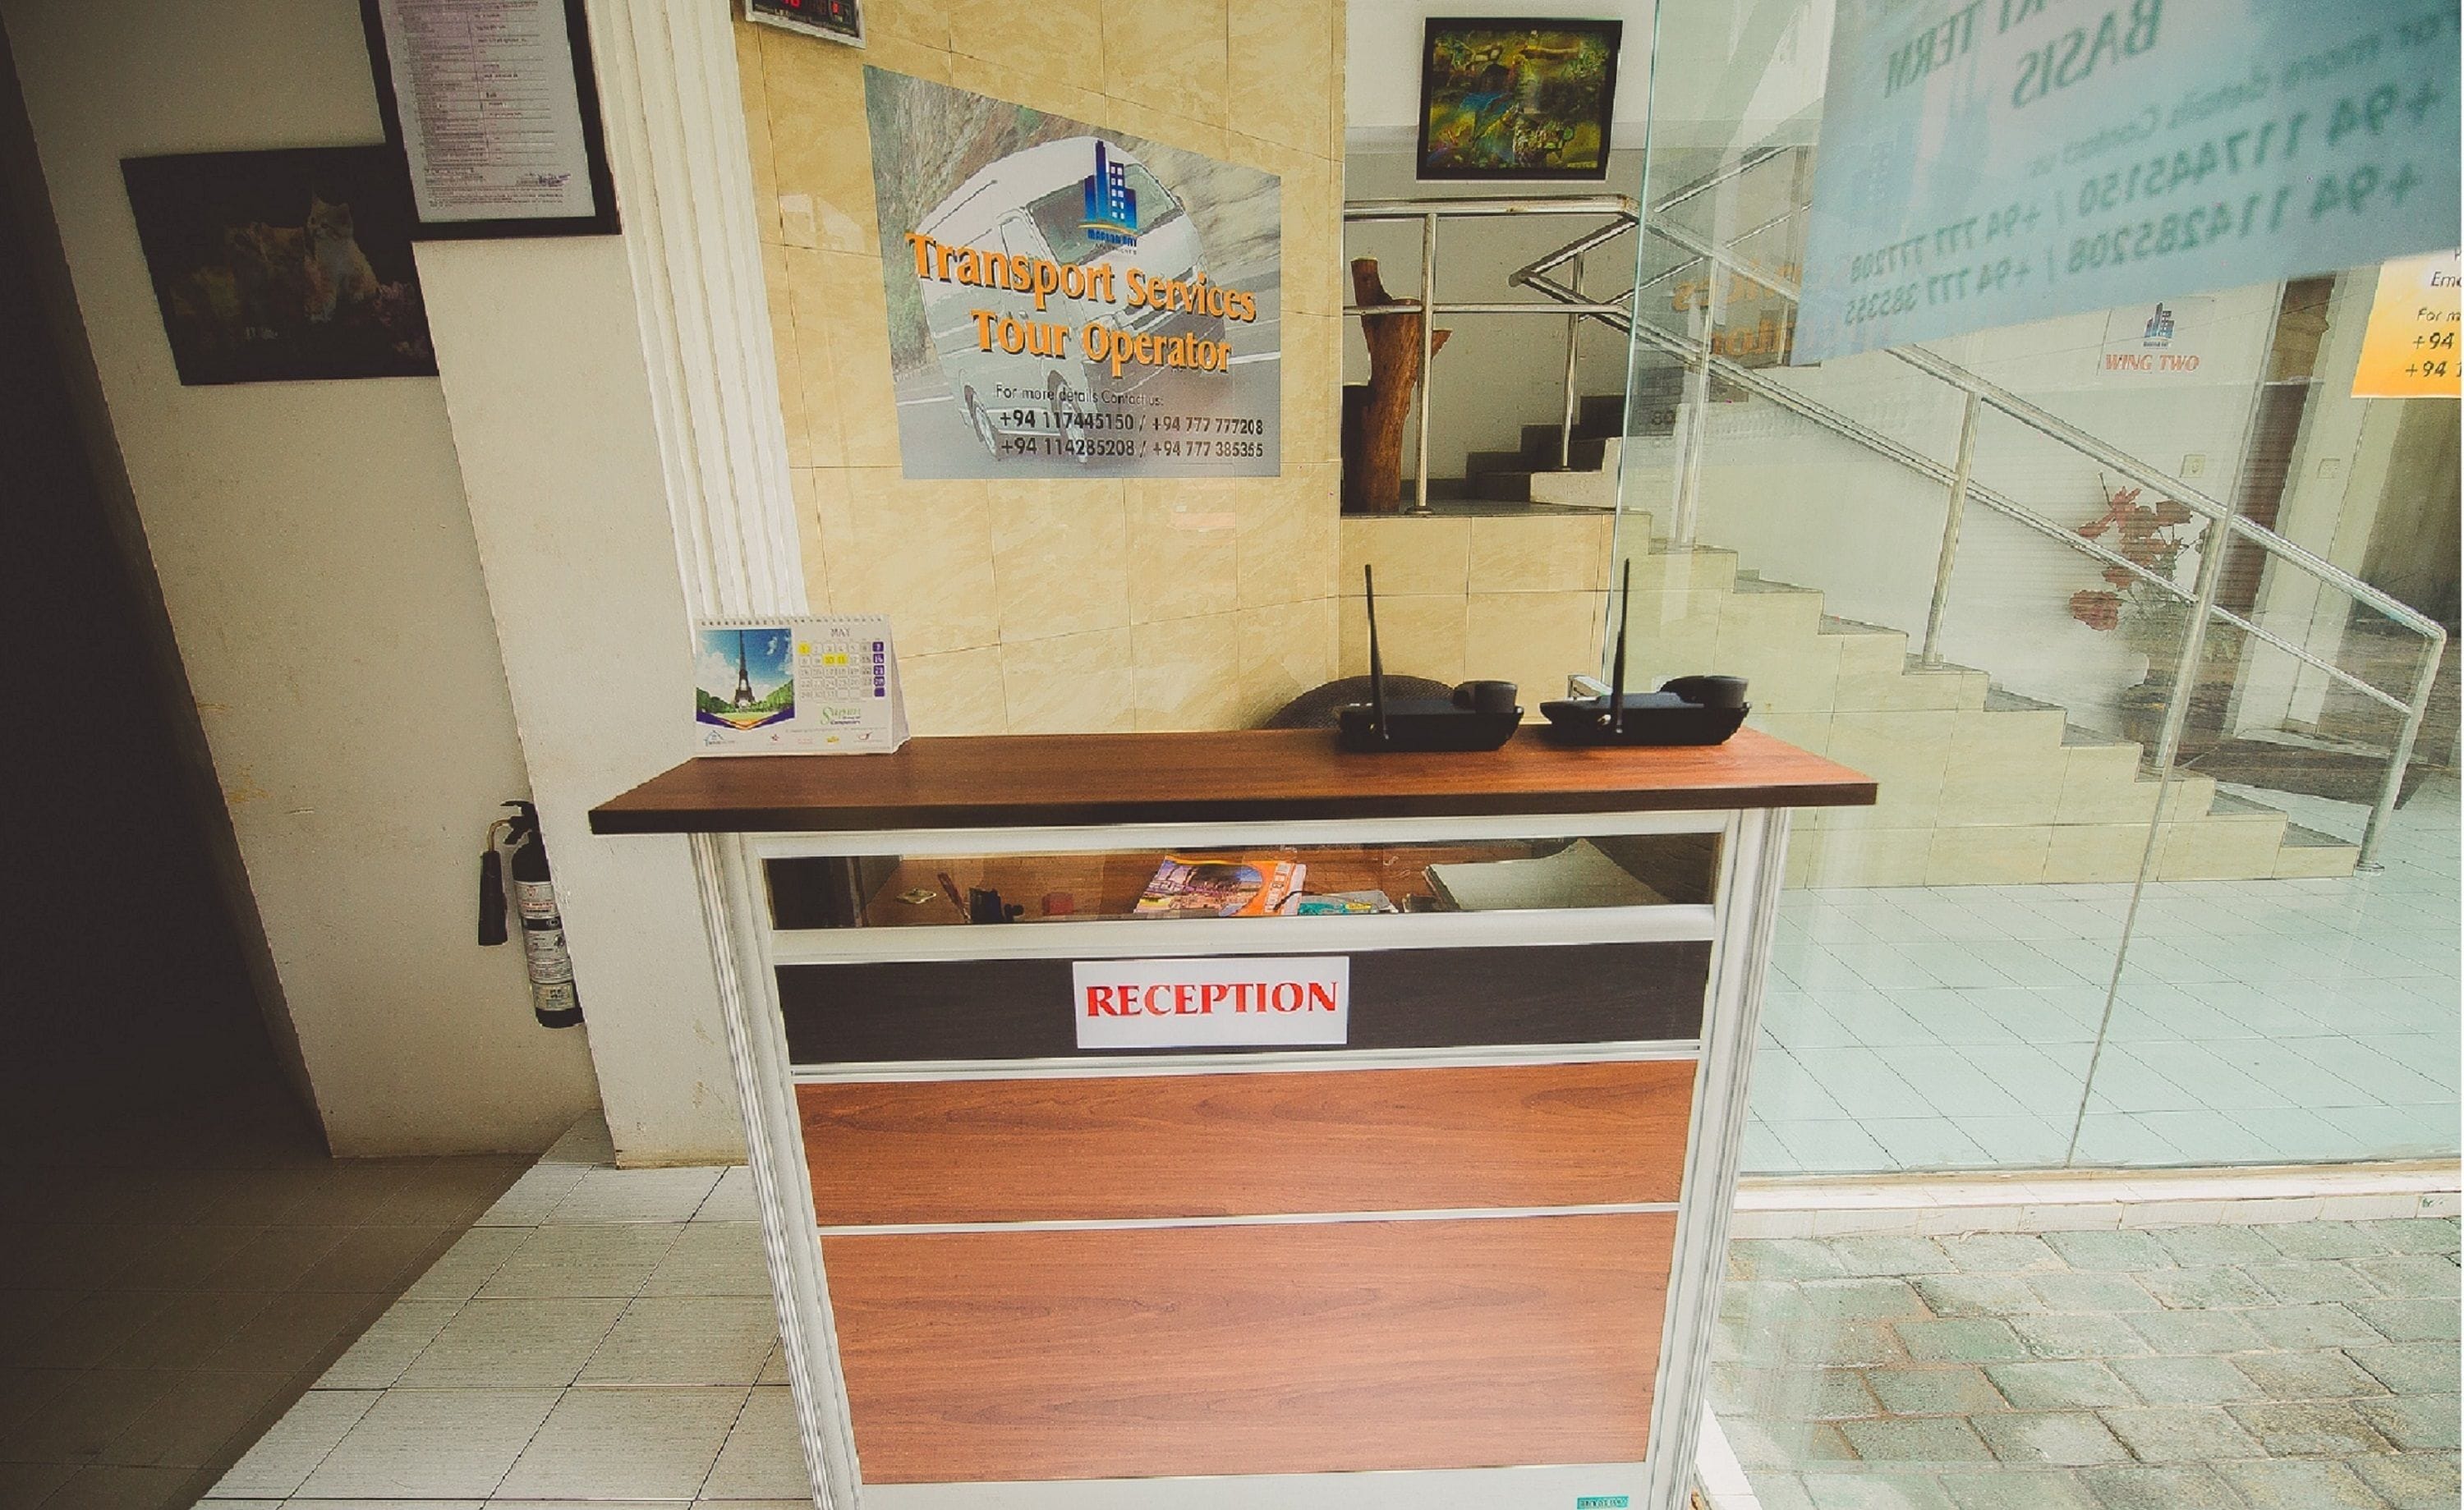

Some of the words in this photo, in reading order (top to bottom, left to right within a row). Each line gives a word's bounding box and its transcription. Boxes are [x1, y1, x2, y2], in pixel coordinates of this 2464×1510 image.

[904, 232, 1115, 312] Transport
[1126, 267, 1257, 323] Services
[2416, 308, 2443, 322] For
[970, 309, 1071, 360] Tour
[1083, 321, 1232, 379] Operator
[2412, 333, 2454, 350] +94
[2106, 354, 2154, 371] WING
[2159, 354, 2200, 372] TWO
[2405, 360, 2448, 378] +94
[996, 384, 1017, 398] For
[1023, 389, 1055, 401] more
[1060, 387, 1098, 403] details
[1101, 389, 1145, 405] Contact
[1000, 410, 1036, 428] +94
[1043, 412, 1134, 430] 117445150
[1152, 415, 1181, 432] +94
[1186, 416, 1211, 433] 777
[1215, 418, 1264, 435] 777208
[1001, 437, 1037, 455] +94
[1044, 439, 1135, 457] 114285208
[1153, 440, 1181, 457] +94
[1187, 441, 1211, 457] 777
[1216, 442, 1264, 458] 385355
[1086, 981, 1338, 1017] RECEPTION
